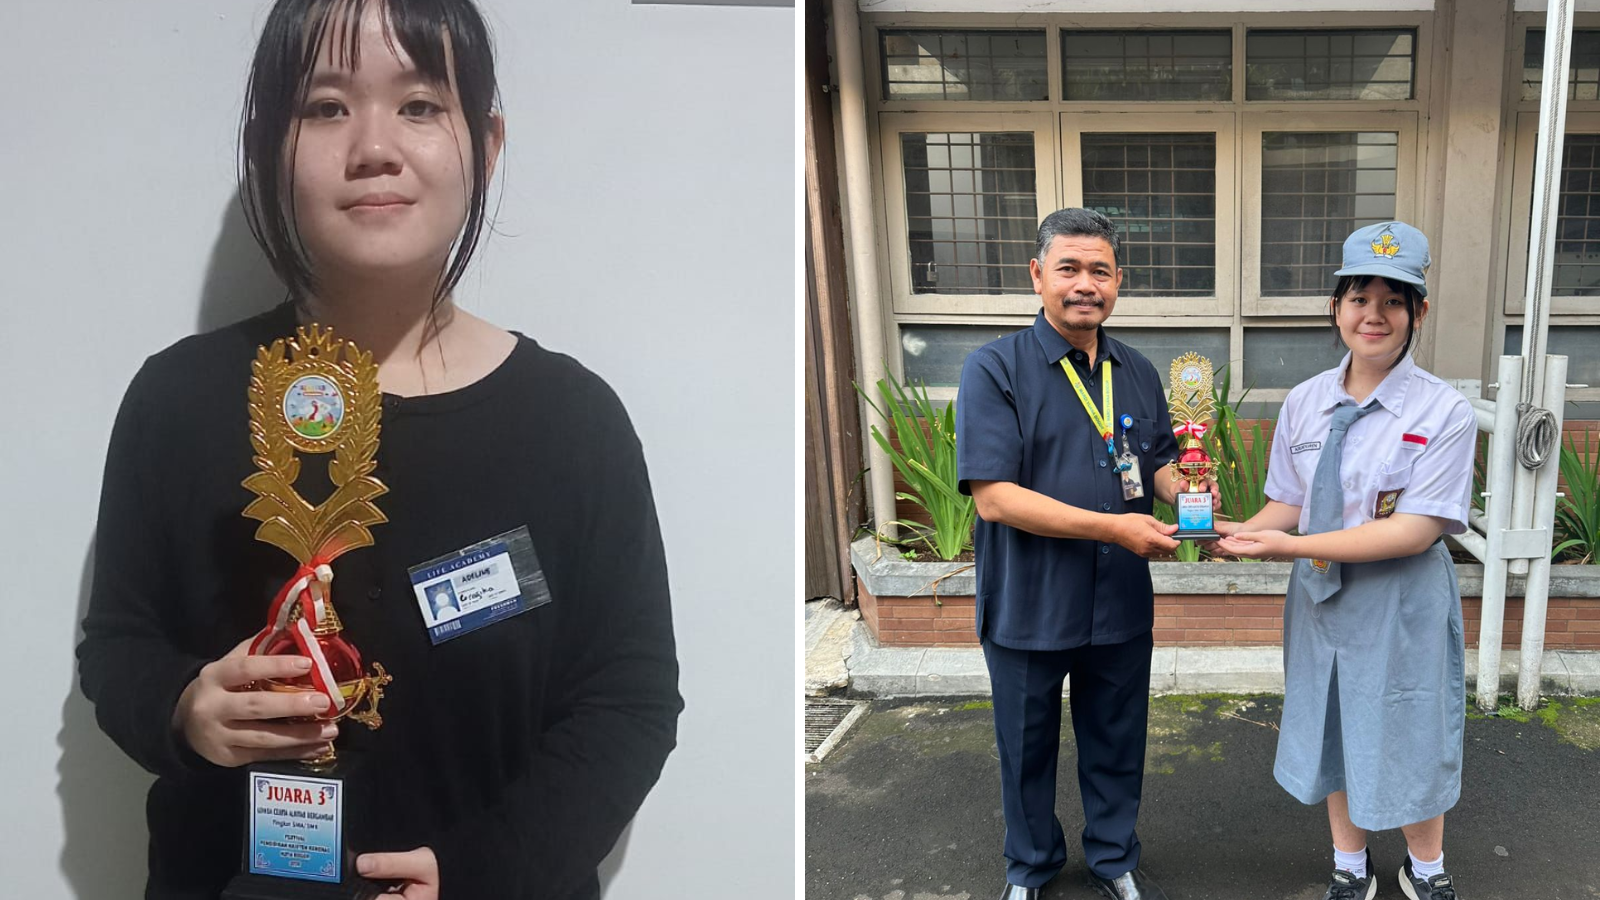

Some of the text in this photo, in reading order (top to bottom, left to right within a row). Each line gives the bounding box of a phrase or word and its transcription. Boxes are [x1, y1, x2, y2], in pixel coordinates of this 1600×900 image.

[427, 550, 492, 579] LIFE ACADEMY
[267, 786, 326, 806] JUARA 3
